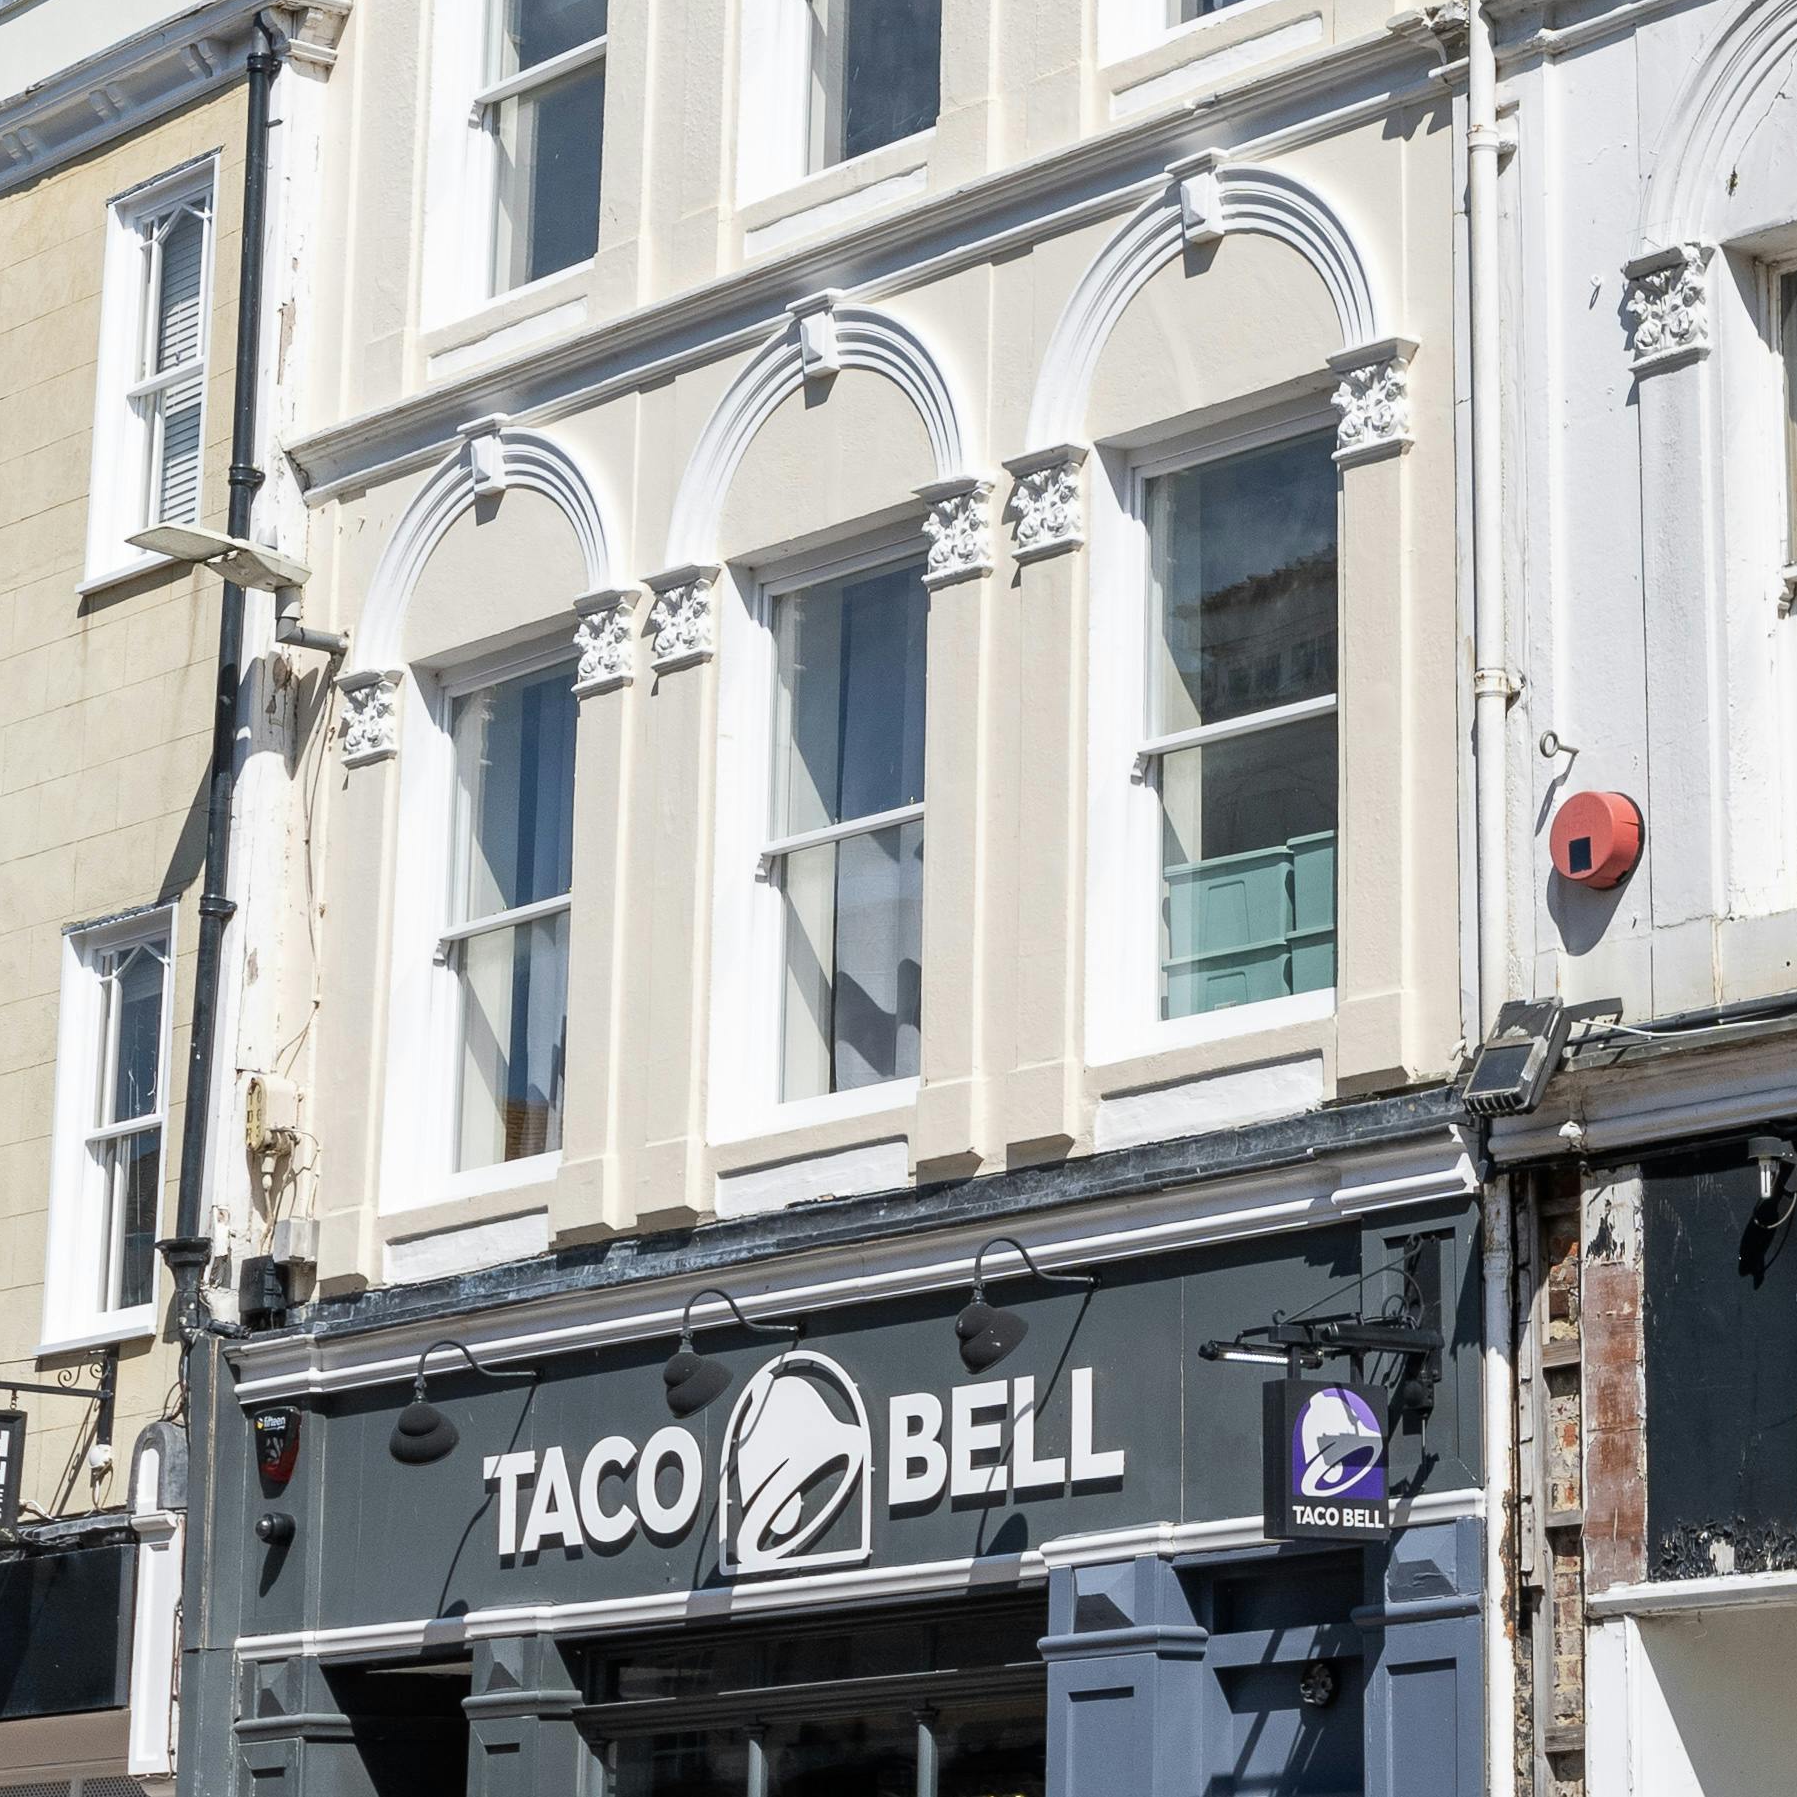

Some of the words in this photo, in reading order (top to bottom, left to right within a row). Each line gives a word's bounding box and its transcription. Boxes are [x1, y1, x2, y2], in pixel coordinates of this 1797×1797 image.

[483, 1425, 704, 1557] TACO
[887, 1365, 1126, 1507] BELL
[1292, 1505, 1340, 1526] TACO
[1342, 1508, 1385, 1529] BELL
